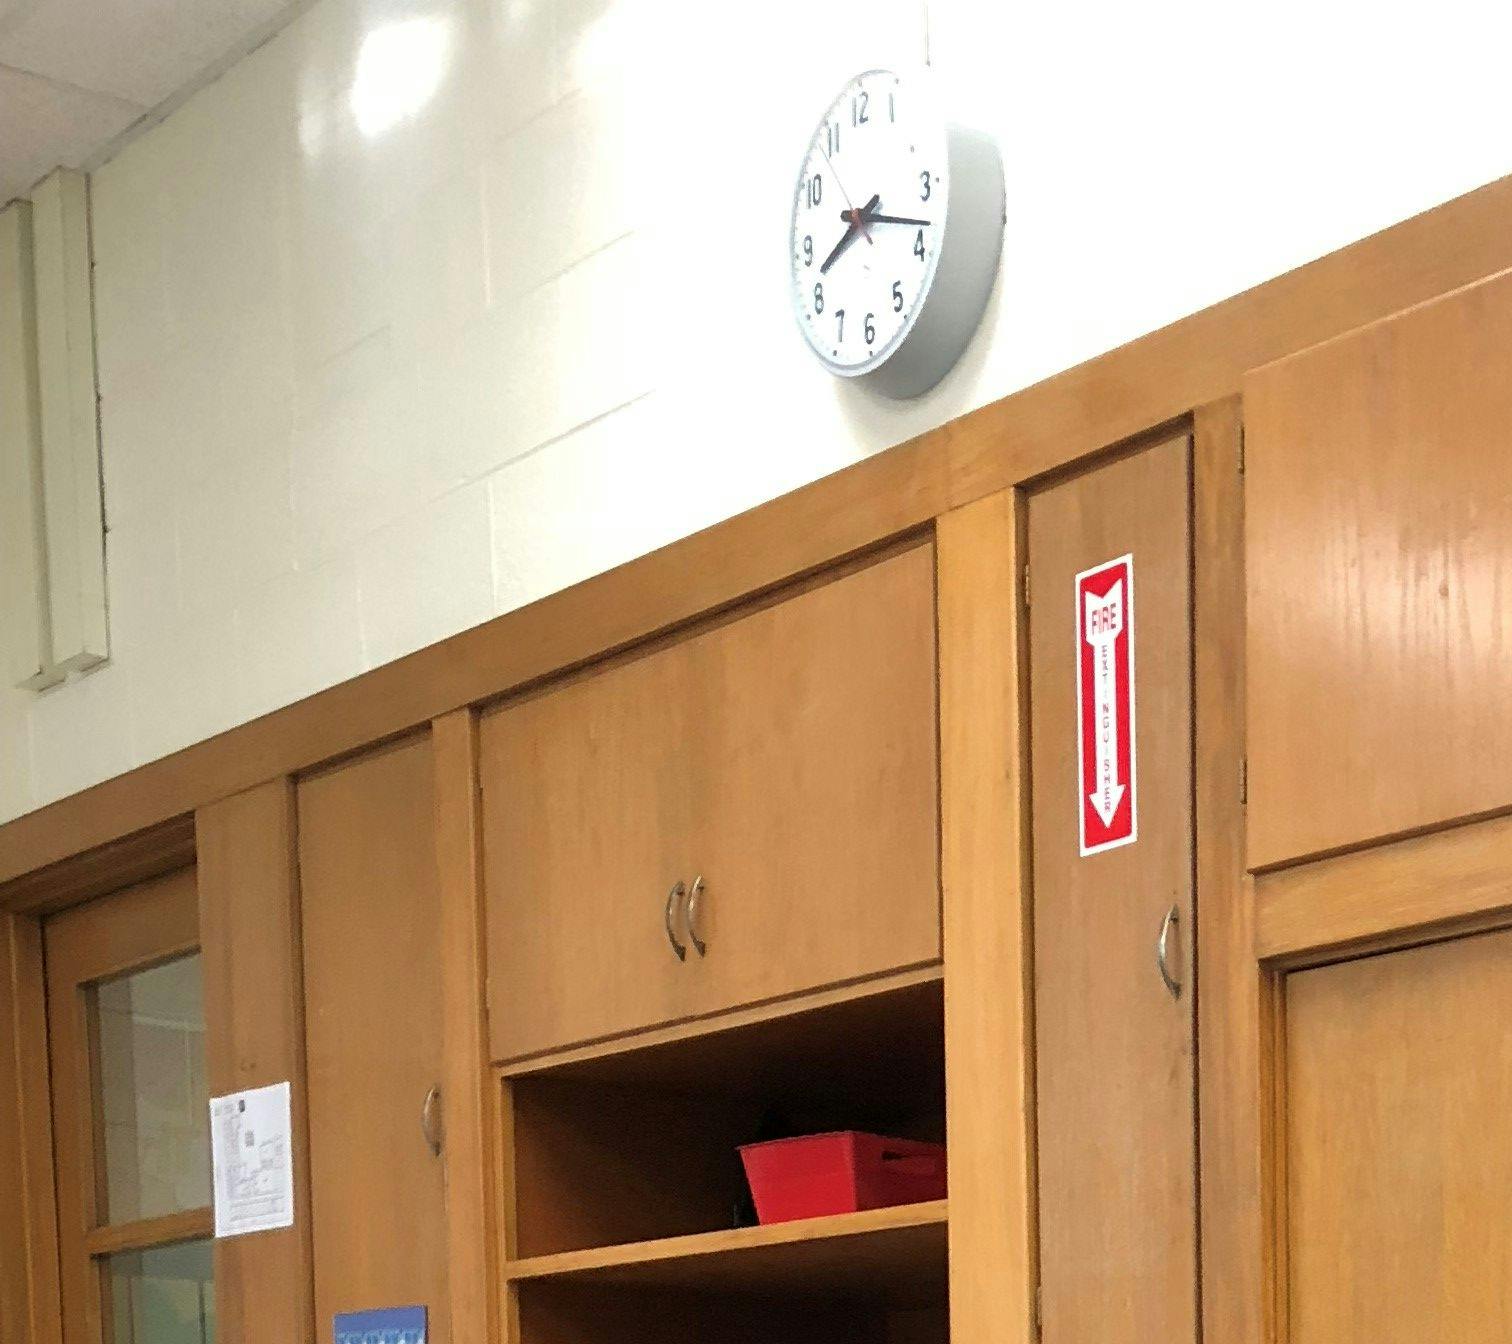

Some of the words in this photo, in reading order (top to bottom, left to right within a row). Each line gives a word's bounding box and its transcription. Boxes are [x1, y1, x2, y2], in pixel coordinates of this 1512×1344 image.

[851, 91, 869, 127] 12
[888, 92, 895, 123] 1
[827, 122, 840, 159] 11
[806, 173, 822, 209] 10
[919, 170, 931, 202] 3
[802, 234, 813, 267] 9
[913, 228, 925, 262] 4
[813, 282, 824, 315] 8
[892, 280, 904, 313] 5
[834, 309, 845, 343] 7
[863, 313, 875, 345] 6
[1091, 602, 1117, 635] FIRE
